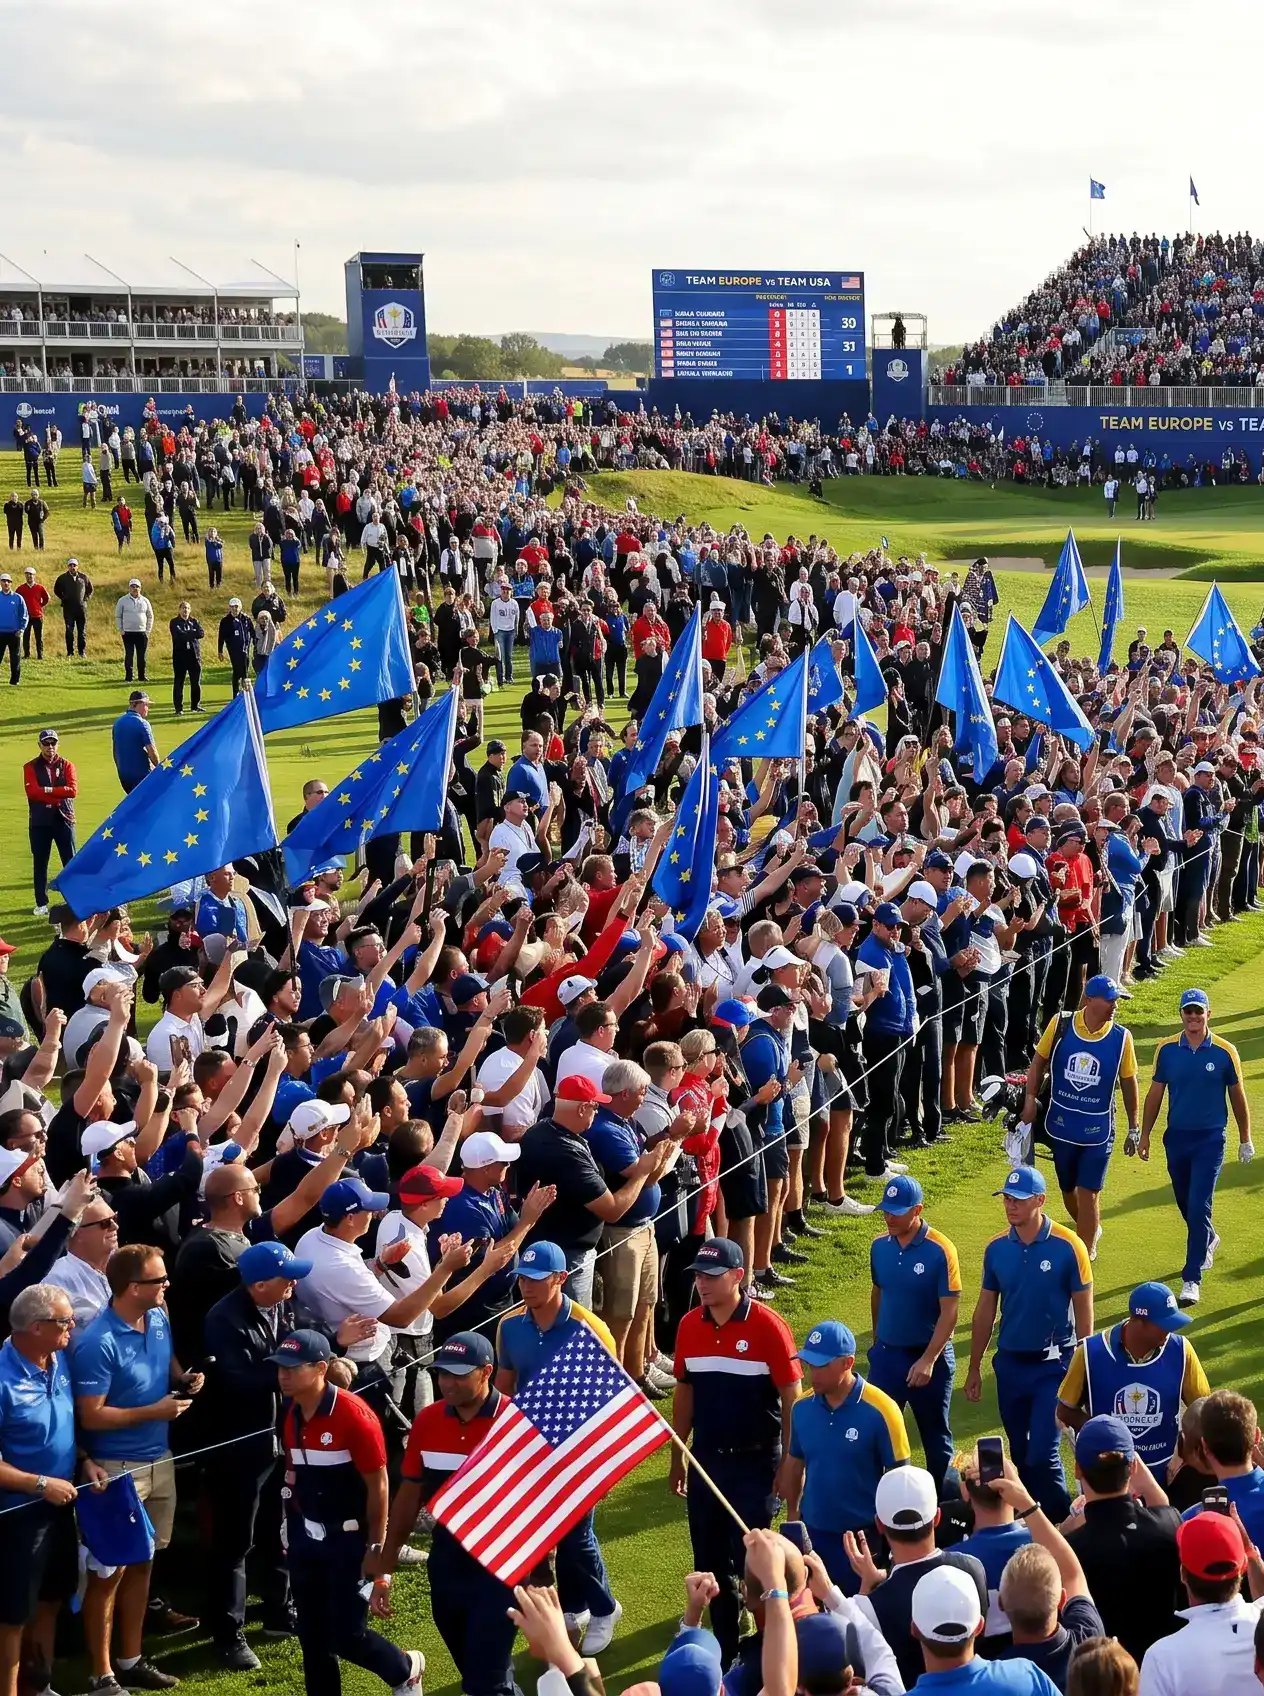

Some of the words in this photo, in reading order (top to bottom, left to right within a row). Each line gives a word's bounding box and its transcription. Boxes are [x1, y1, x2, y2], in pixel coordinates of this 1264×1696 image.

[686, 276, 716, 285] TEAM
[718, 276, 762, 286] EUROPE
[777, 277, 807, 287] TEAM
[809, 278, 831, 287] USA
[846, 364, 853, 376] 1
[1100, 416, 1144, 431] TEAM
[1148, 416, 1213, 431] EUROPE
